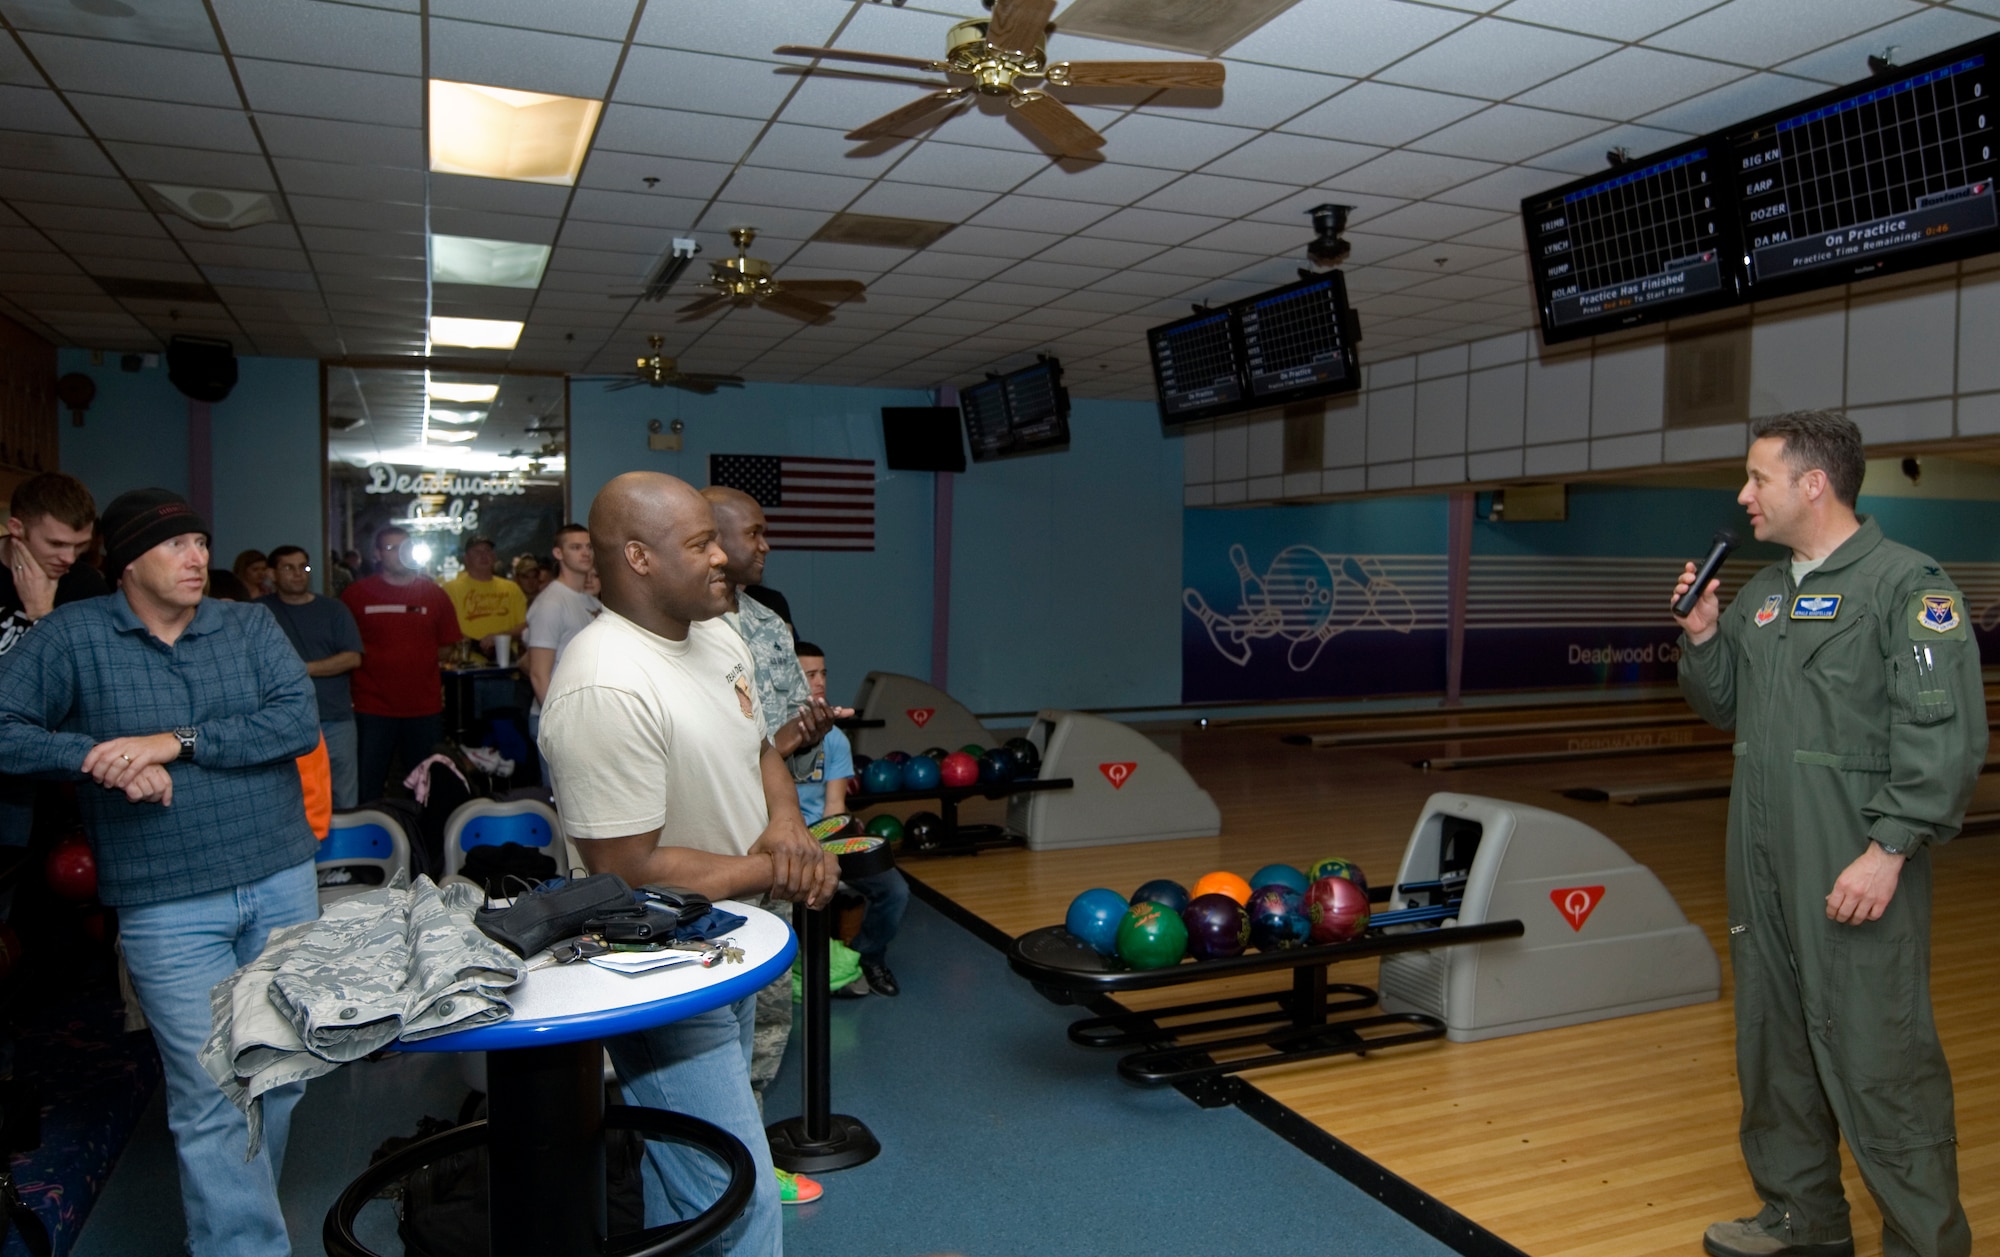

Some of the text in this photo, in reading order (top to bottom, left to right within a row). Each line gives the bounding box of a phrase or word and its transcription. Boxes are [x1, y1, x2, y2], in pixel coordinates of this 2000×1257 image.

[1974, 83, 1982, 97] 0
[1978, 115, 1986, 129] 0
[1742, 148, 1779, 169] BIG KN
[1982, 146, 1990, 160] 0
[1700, 171, 1707, 183] 0
[1746, 179, 1773, 195] EARP
[1704, 197, 1711, 209] 0
[1750, 203, 1787, 221] DOZER
[1708, 222, 1715, 234] 0
[1825, 219, 1906, 247] On Practice
[1544, 239, 1569, 255] LYNCH
[1754, 230, 1788, 248] DA MA
[1792, 223, 1949, 267] Practice Time Remaining: 0:46
[1551, 284, 1578, 299] BOLAN
[1579, 271, 1685, 306] Practice Has Finished
[1634, 294, 1644, 303] To
[1645, 289, 1666, 301] Start
[1668, 285, 1685, 298] Play
[365, 463, 526, 496] Deadwood
[1568, 642, 1682, 665] Deadwood Ca
